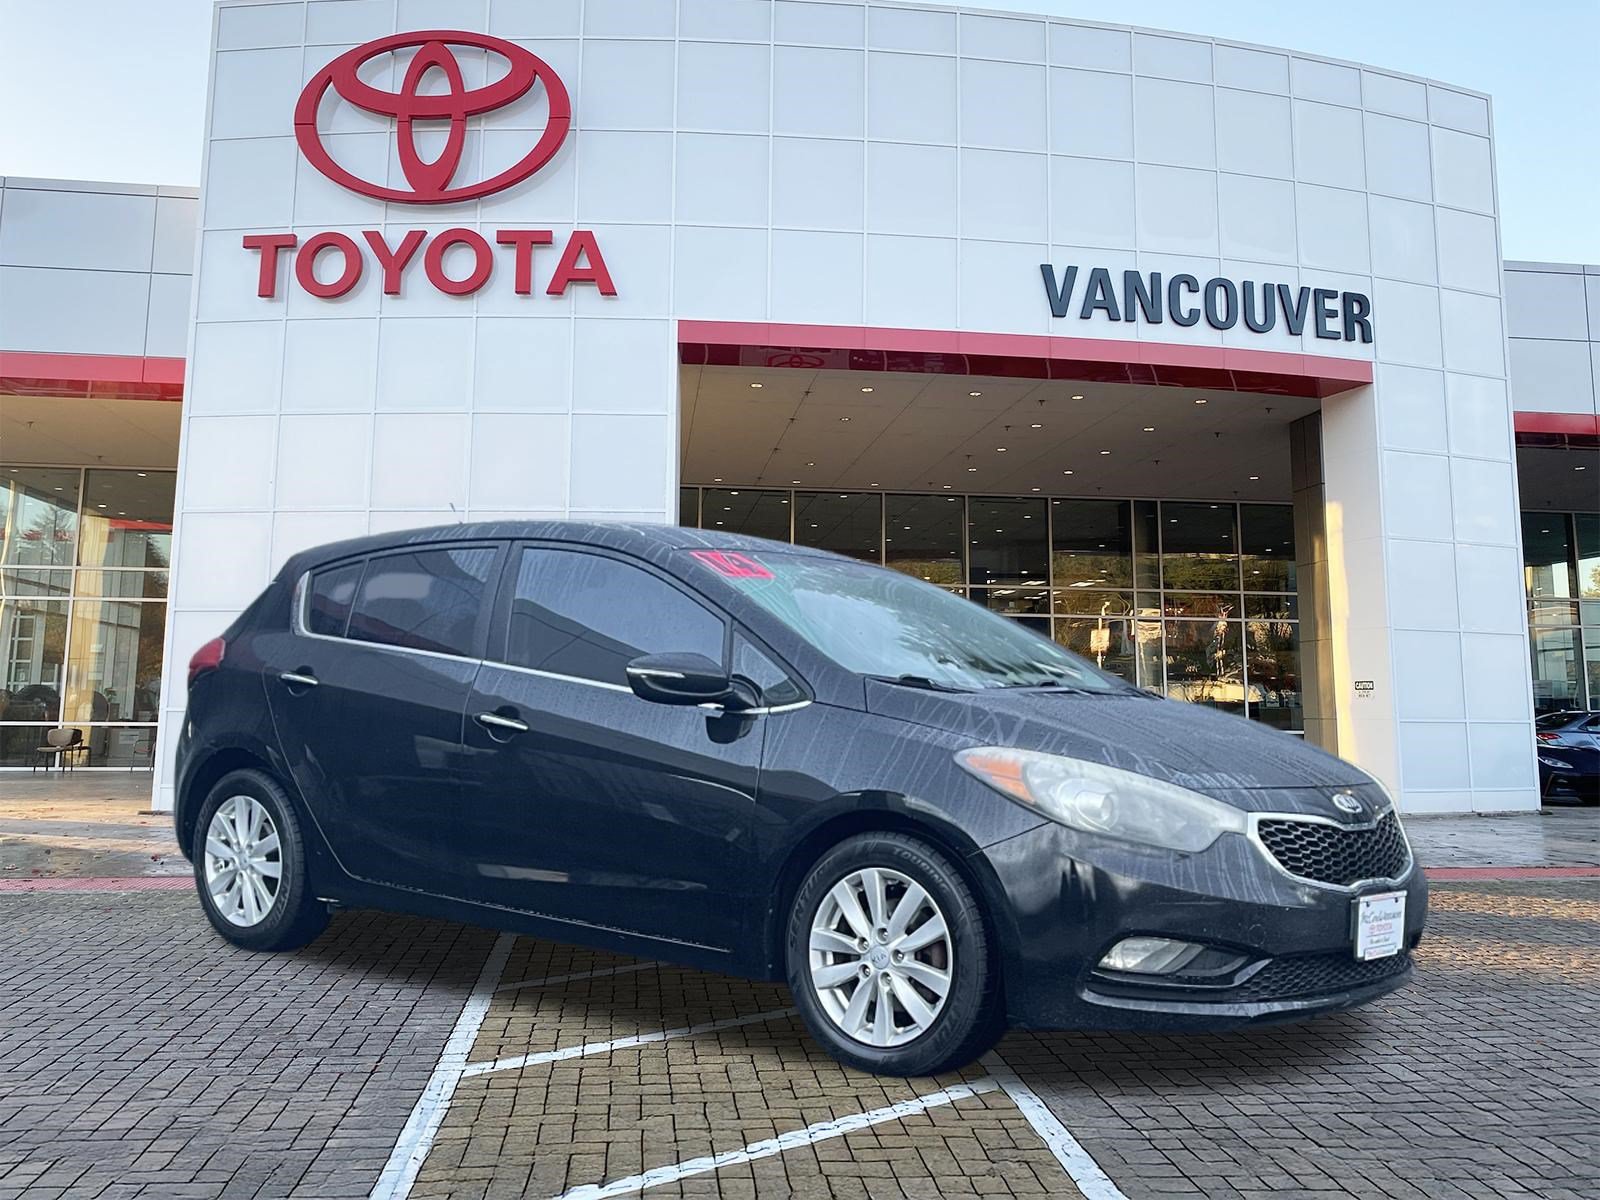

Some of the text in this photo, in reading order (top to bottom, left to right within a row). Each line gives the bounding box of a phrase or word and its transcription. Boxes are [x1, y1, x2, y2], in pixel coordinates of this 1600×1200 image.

[243, 228, 618, 299] TOYOTA
[1040, 263, 1373, 344] VANCOUVER
[893, 848, 949, 891] TOURING
